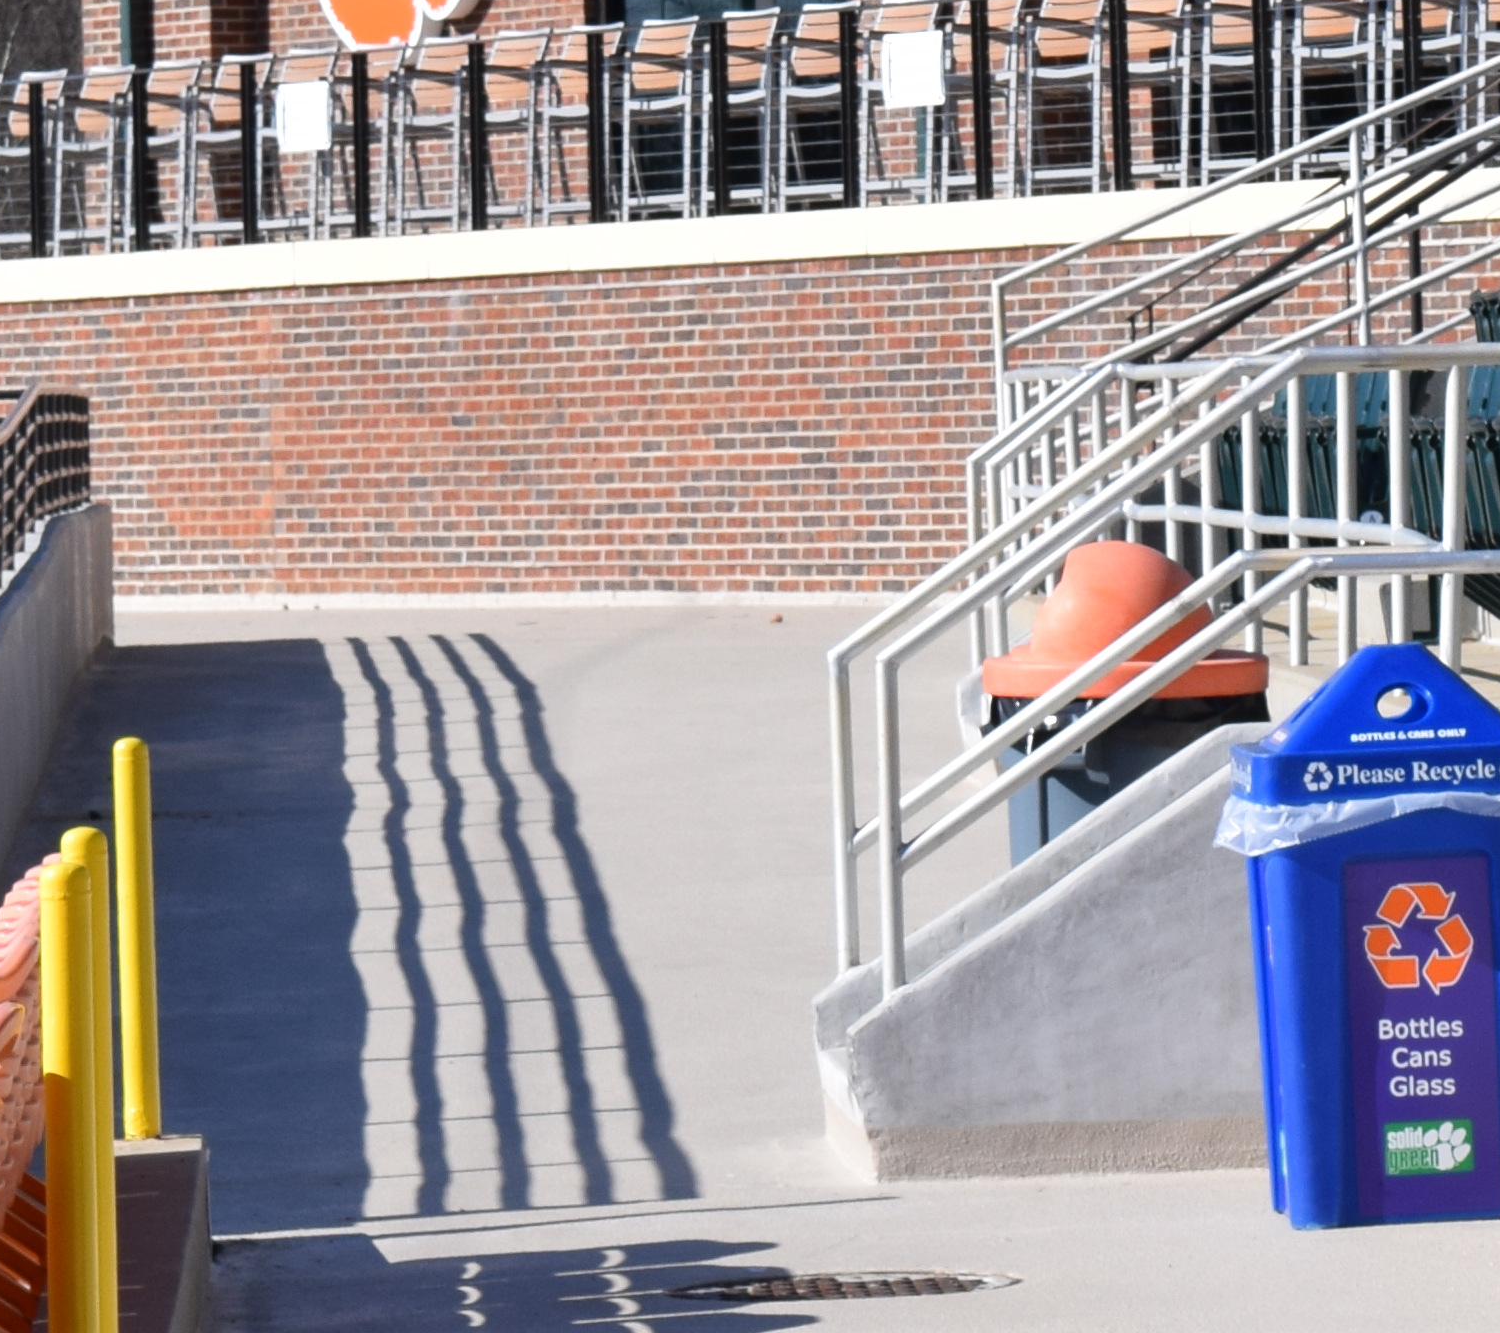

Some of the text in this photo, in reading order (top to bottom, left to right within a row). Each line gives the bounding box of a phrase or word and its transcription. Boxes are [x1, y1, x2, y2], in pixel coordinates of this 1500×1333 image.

[1350, 728, 1466, 742] BOTTLES & CANS ONLY
[1337, 758, 1495, 785] Please Recycle
[1378, 1016, 1464, 1040] Bottles
[1391, 1046, 1452, 1069] Cans
[1389, 1074, 1457, 1097] Glass
[1387, 1126, 1423, 1149] solid
